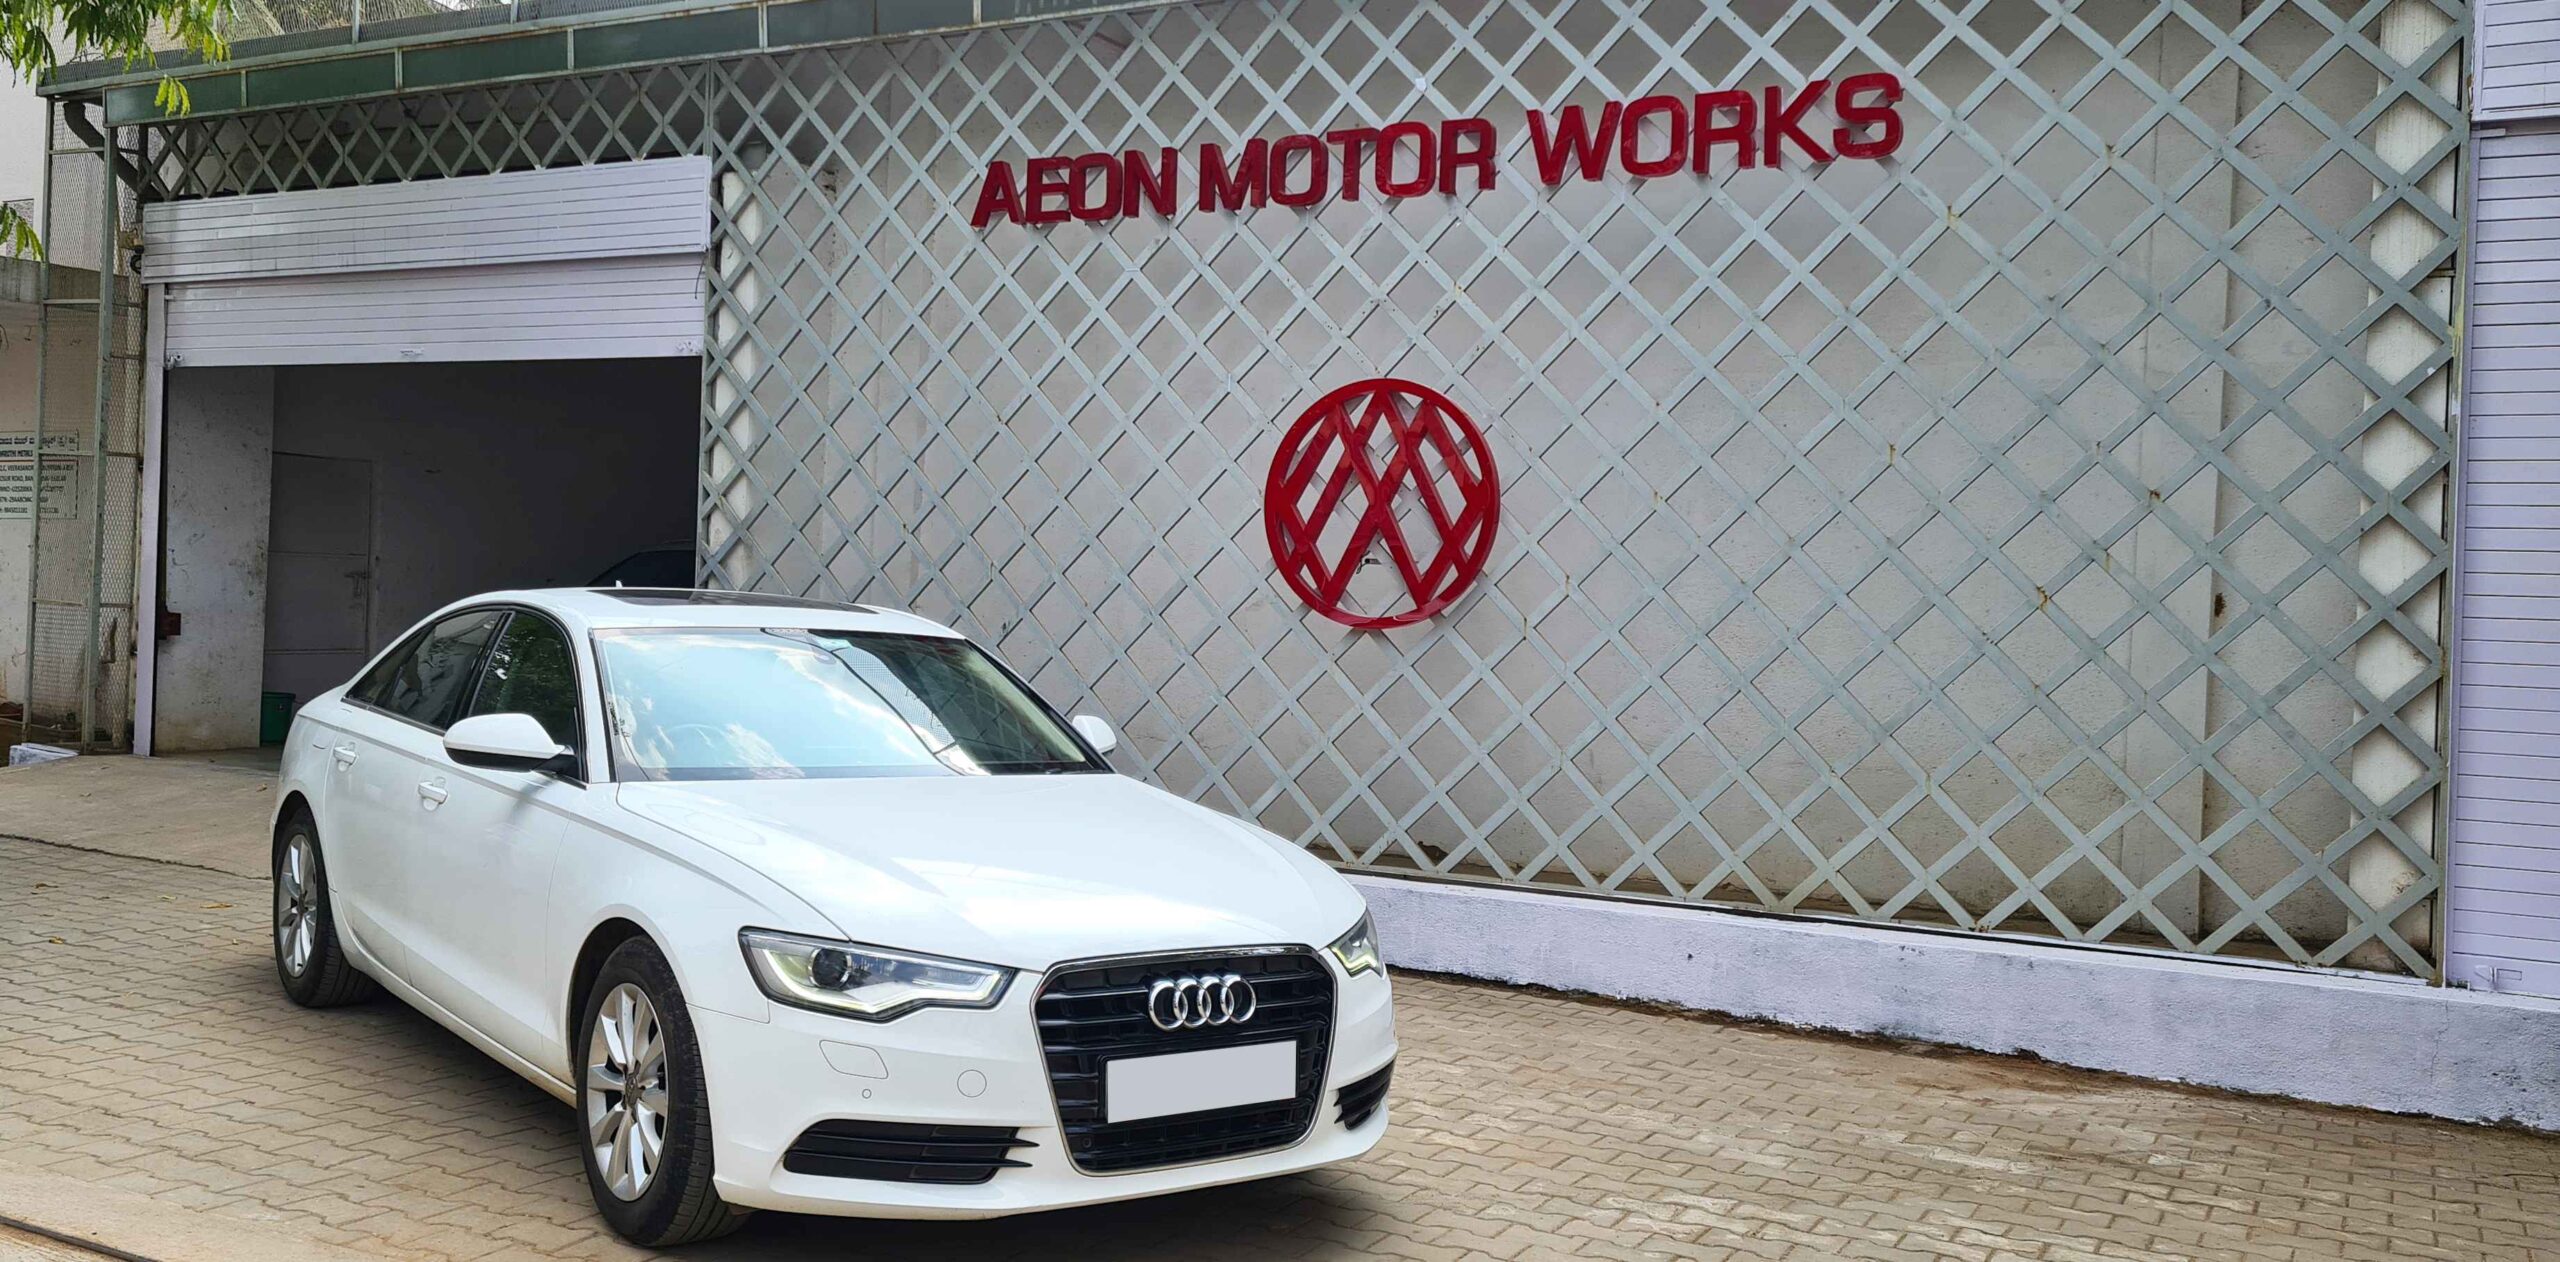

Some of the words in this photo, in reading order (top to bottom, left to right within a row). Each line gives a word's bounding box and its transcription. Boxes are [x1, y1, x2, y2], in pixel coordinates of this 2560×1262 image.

[972, 146, 1176, 228] AEON
[1199, 118, 1495, 213] MOTOR
[1526, 73, 1903, 185] WORKS
